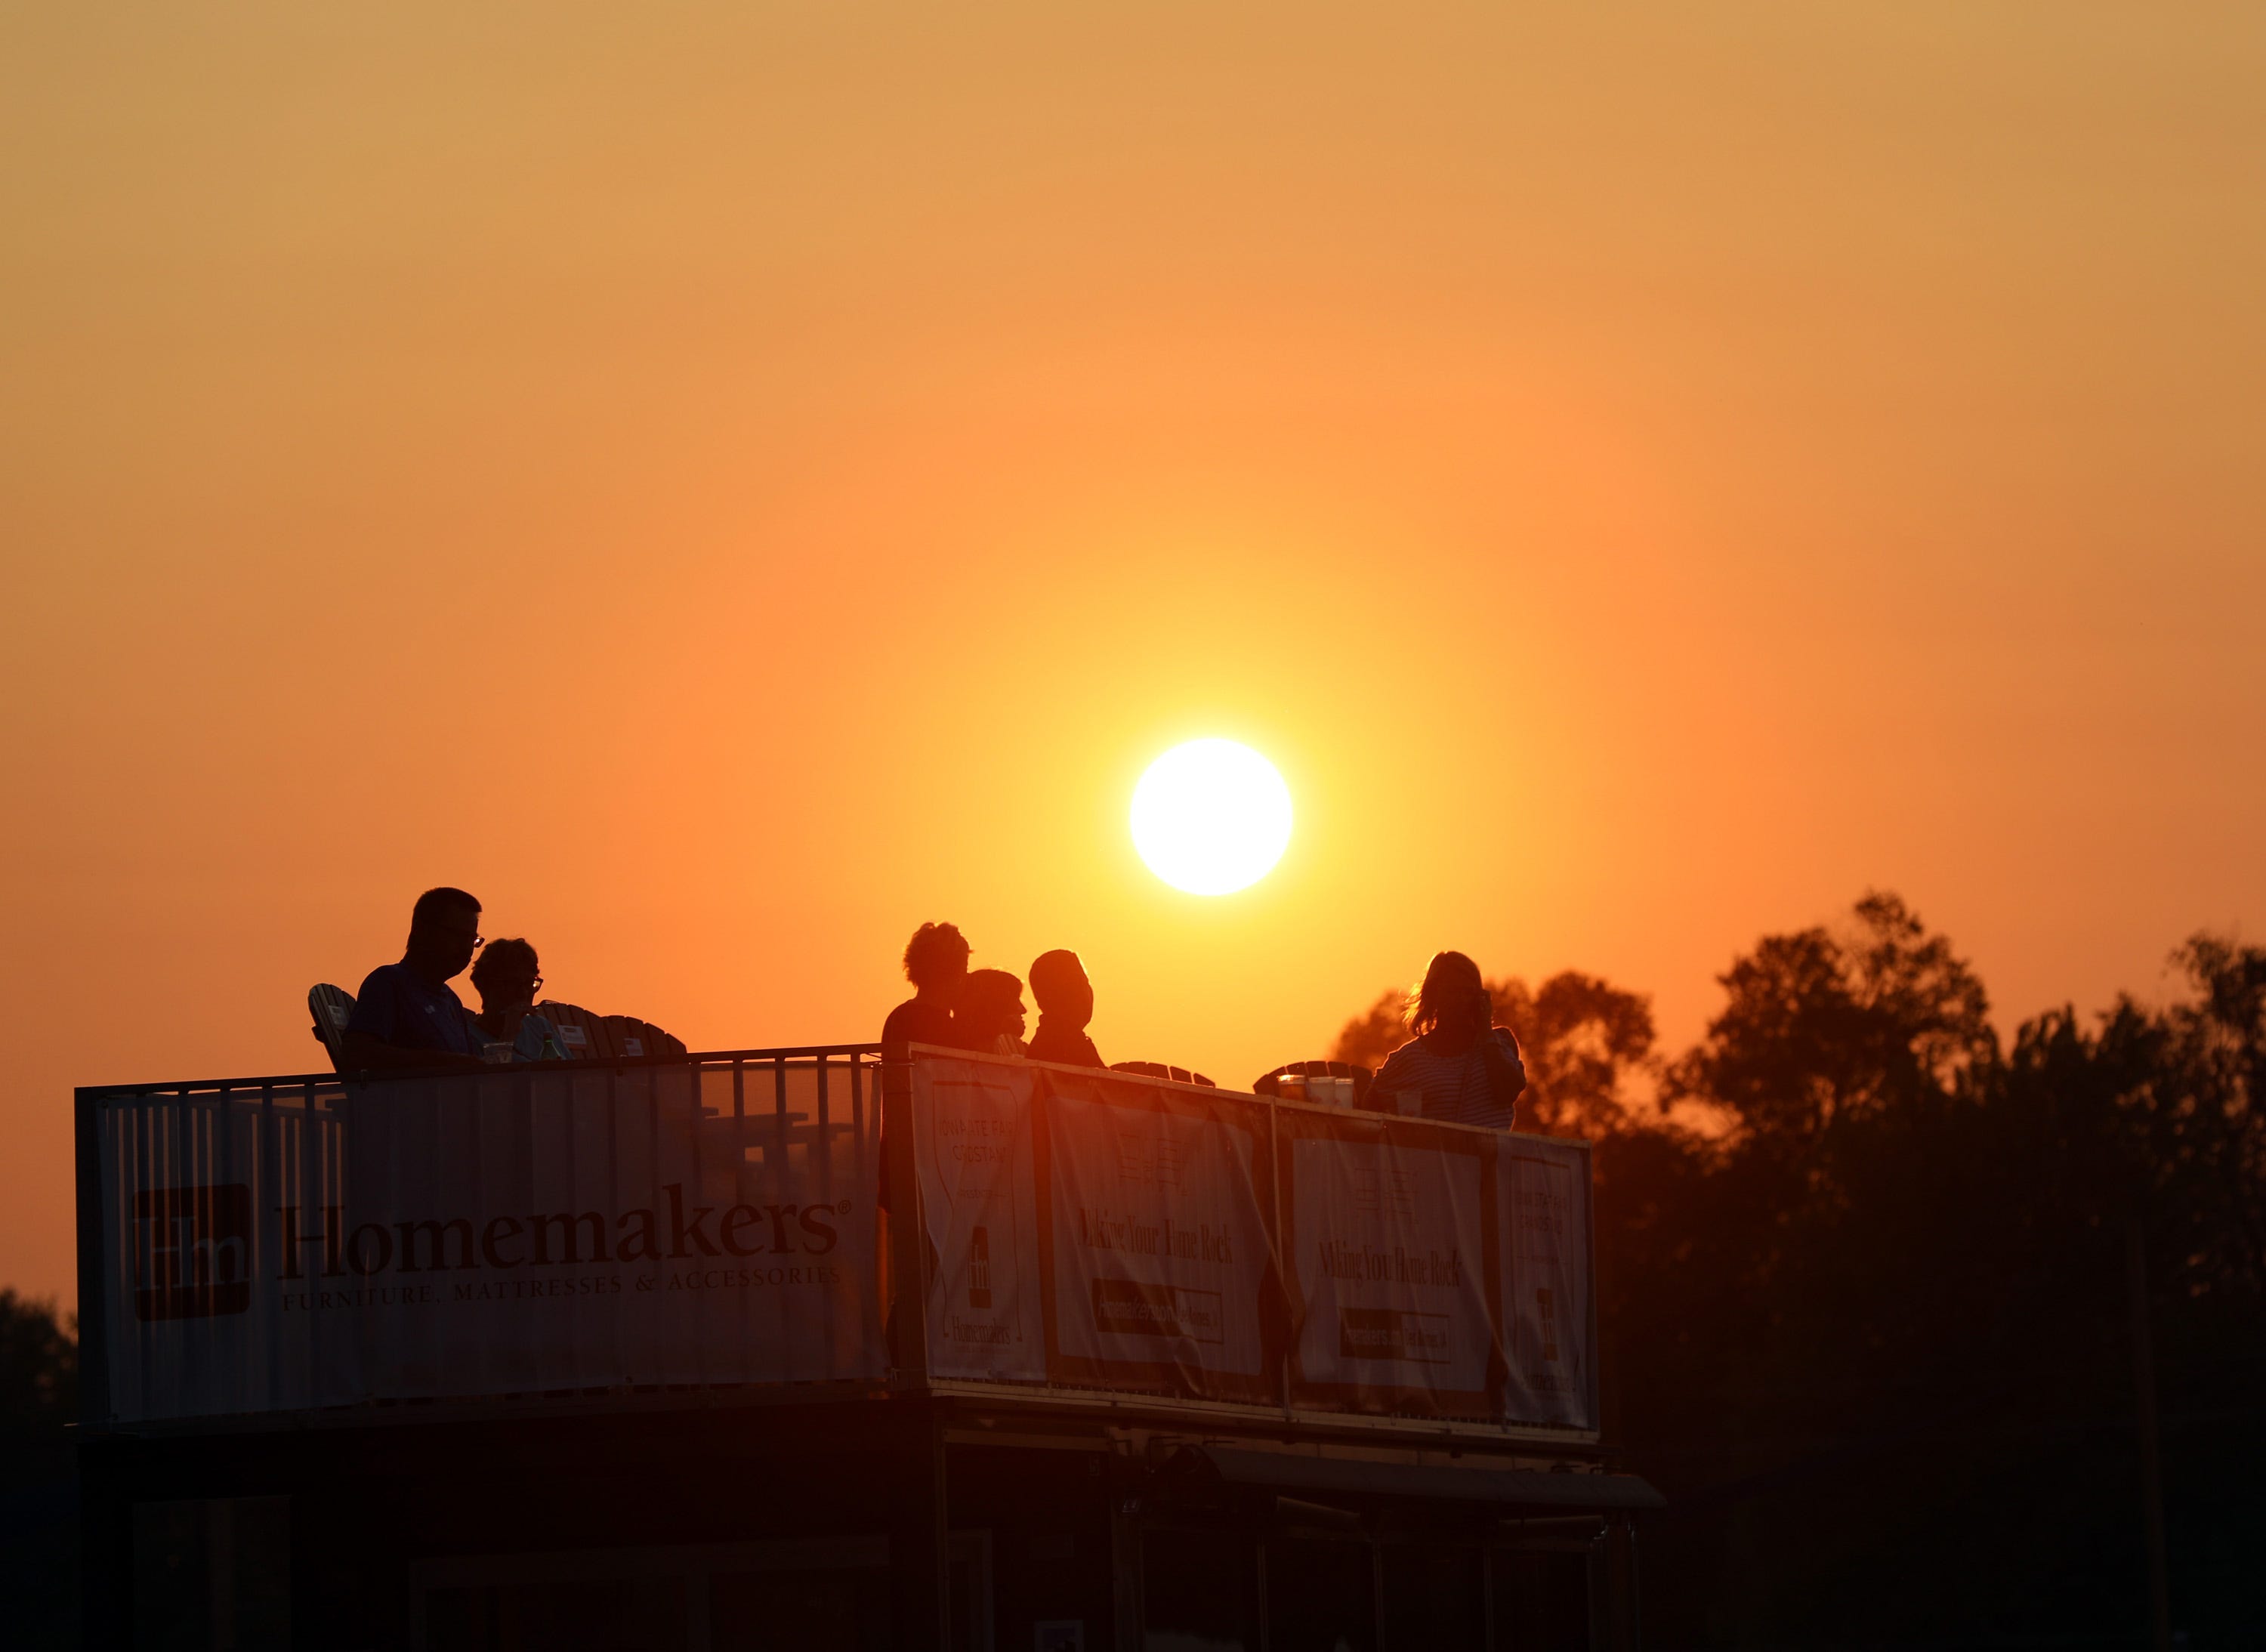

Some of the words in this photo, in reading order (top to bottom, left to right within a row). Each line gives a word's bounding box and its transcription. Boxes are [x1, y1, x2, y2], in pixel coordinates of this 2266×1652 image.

[133, 1216, 250, 1291] Hm
[1126, 1215, 1159, 1255] Your
[282, 1284, 441, 1312] FURNITURE,
[453, 1274, 622, 1302] MATTRESSES
[636, 1274, 656, 1292] &
[668, 1265, 841, 1291] ACCESSORIES
[1431, 1249, 1462, 1288] Rock
[952, 1315, 1011, 1345] Homemakers
